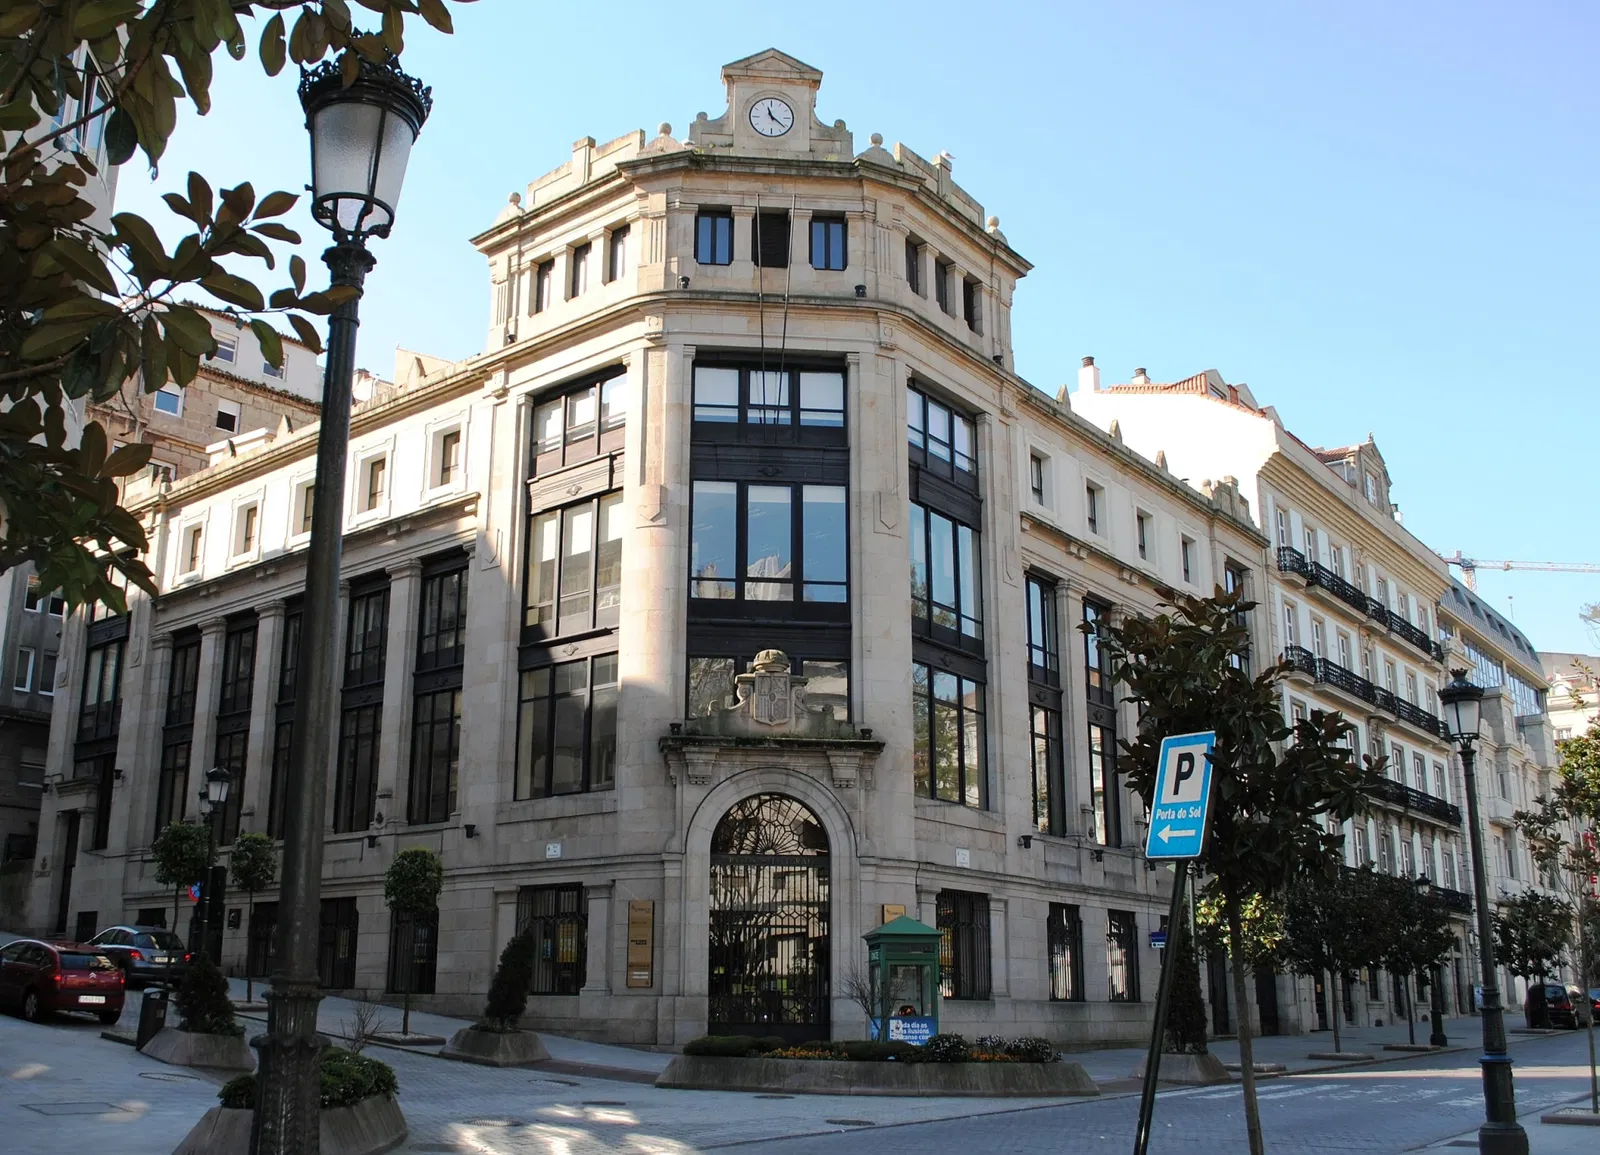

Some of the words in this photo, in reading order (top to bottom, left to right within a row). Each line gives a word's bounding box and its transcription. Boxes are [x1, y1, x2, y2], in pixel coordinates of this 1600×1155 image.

[1173, 752, 1195, 795] P
[1156, 808, 1175, 820] Porta
[1177, 808, 1186, 819] do
[1188, 806, 1201, 817] Sol
